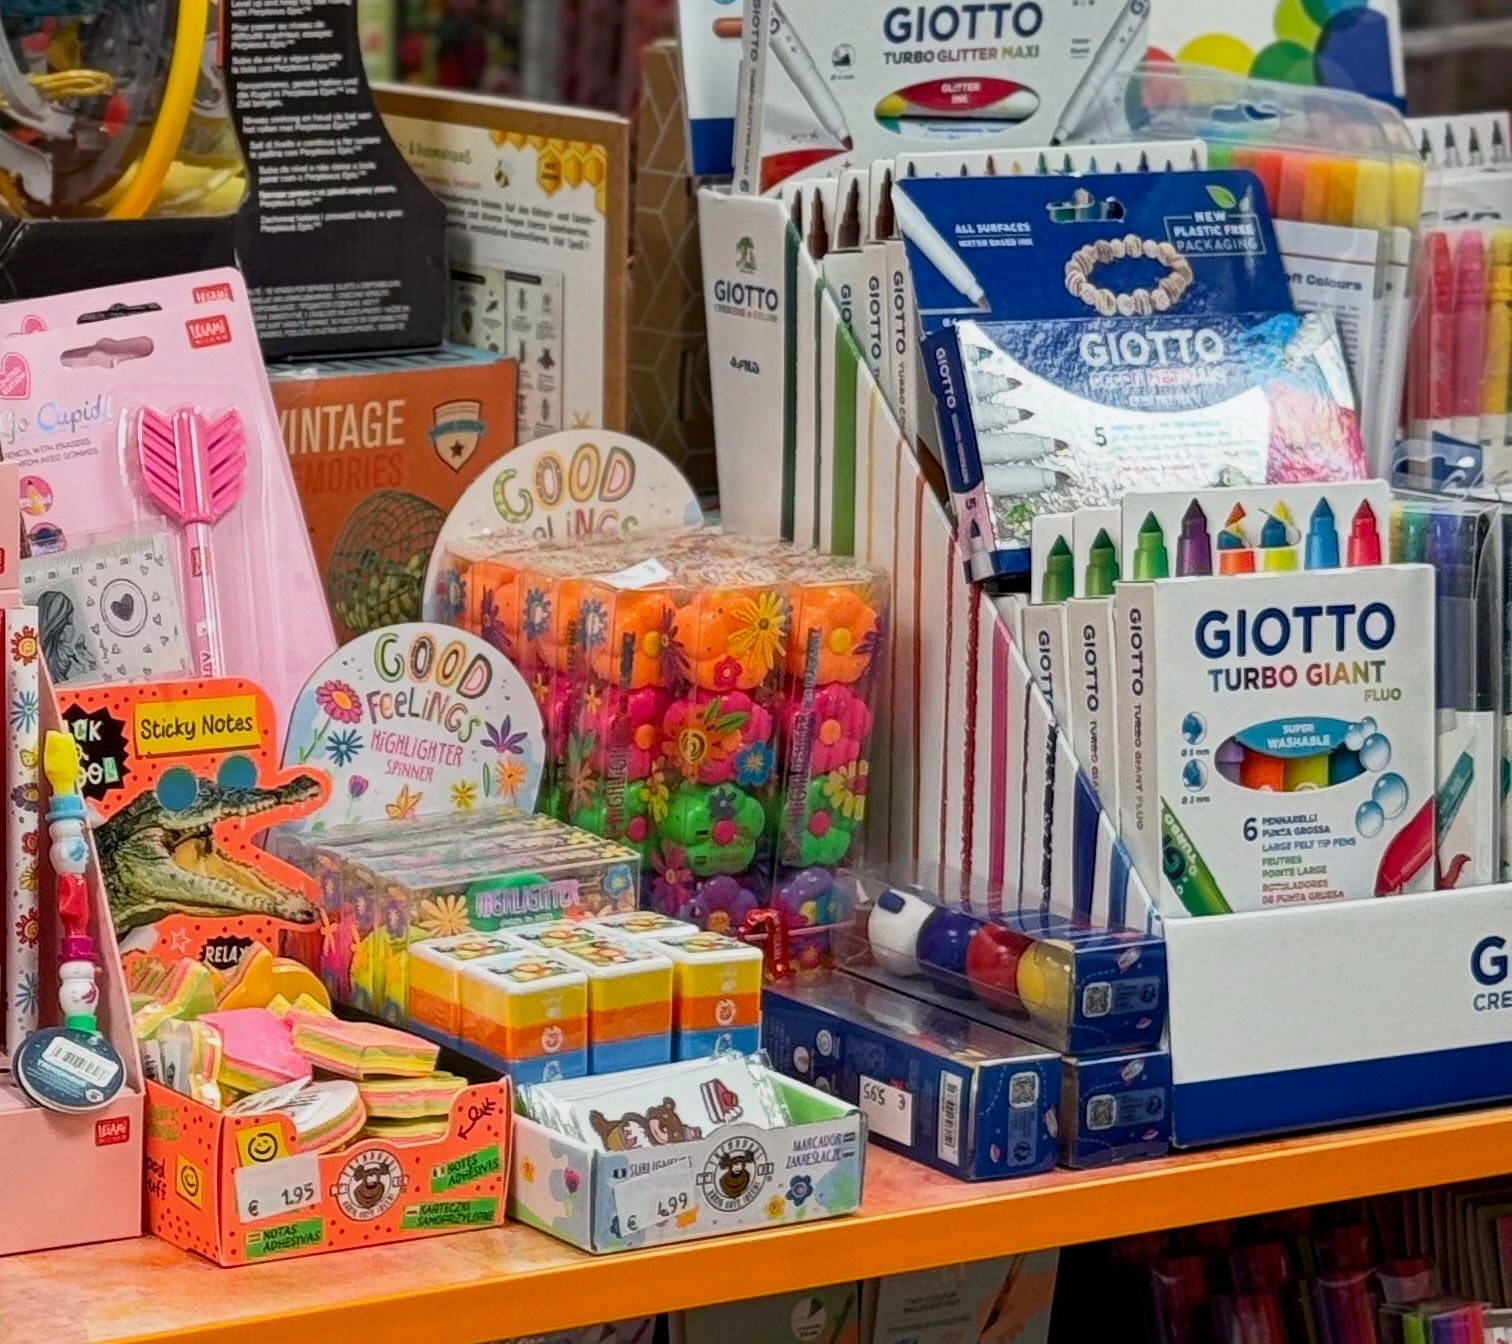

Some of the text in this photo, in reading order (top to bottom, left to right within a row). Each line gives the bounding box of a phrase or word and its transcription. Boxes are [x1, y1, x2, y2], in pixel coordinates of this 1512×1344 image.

[883, 1, 1043, 44] GIOTTO
[883, 45, 1039, 66] TURBO GLITTER MAXI
[1194, 211, 1226, 223] NEW
[1176, 237, 1258, 252] PACKAGING
[714, 280, 778, 311] GIOTTO
[869, 275, 882, 360] GIOTTO
[893, 270, 906, 355] GIOTTO
[1079, 328, 1224, 367] GIOTTO
[935, 347, 956, 409] GIOTTO
[294, 452, 404, 495] EMORIES
[1195, 602, 1395, 659] GIOTTO
[373, 632, 493, 701] GOOD
[1129, 607, 1144, 697] GIOTTO
[1083, 624, 1099, 712] GIOTTO
[1207, 660, 1386, 693] TURBO GIANT
[1364, 688, 1402, 702] FLUO
[140, 714, 253, 740] Sticky Notes
[1267, 734, 1331, 750] WASHABLE
[1282, 723, 1315, 734] SUPER
[1243, 817, 1258, 842] 6
[247, 1199, 259, 1217] €
[627, 1214, 638, 1231] €
[263, 1223, 299, 1240] NOTAS
